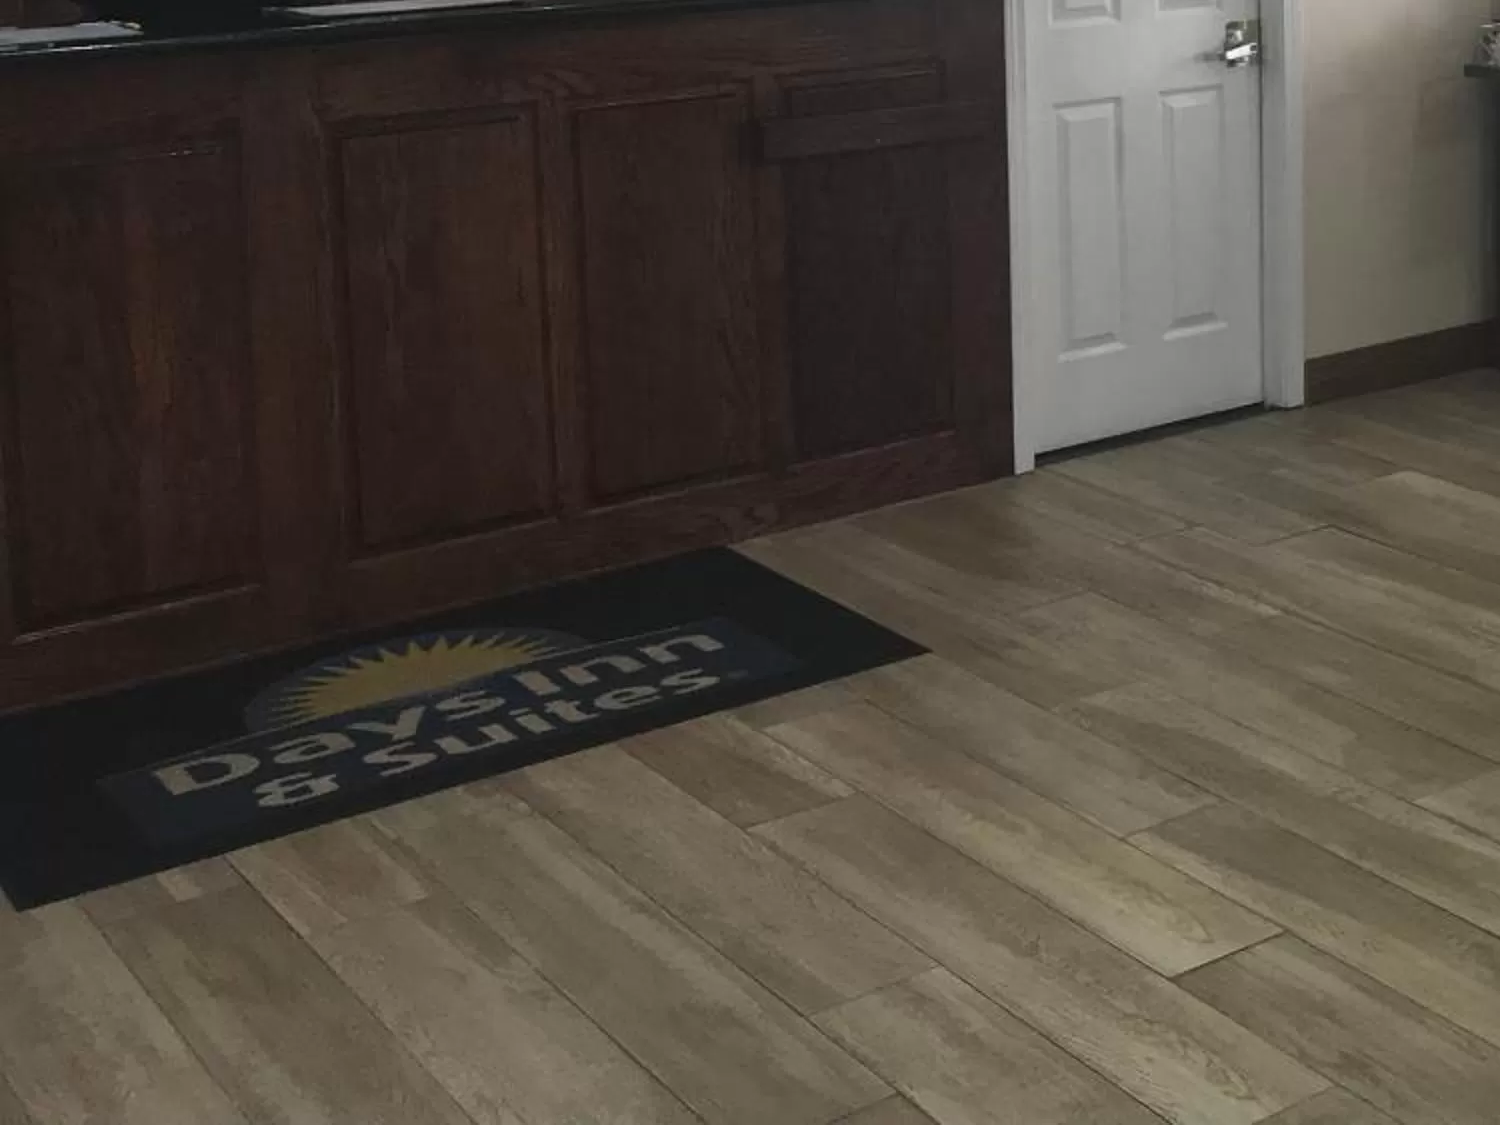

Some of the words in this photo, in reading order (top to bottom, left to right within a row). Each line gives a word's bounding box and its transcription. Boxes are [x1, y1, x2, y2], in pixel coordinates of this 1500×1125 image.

[154, 690, 506, 796] Days
[512, 634, 725, 696] Inn
[252, 772, 341, 807] &
[362, 668, 721, 777] Suites
